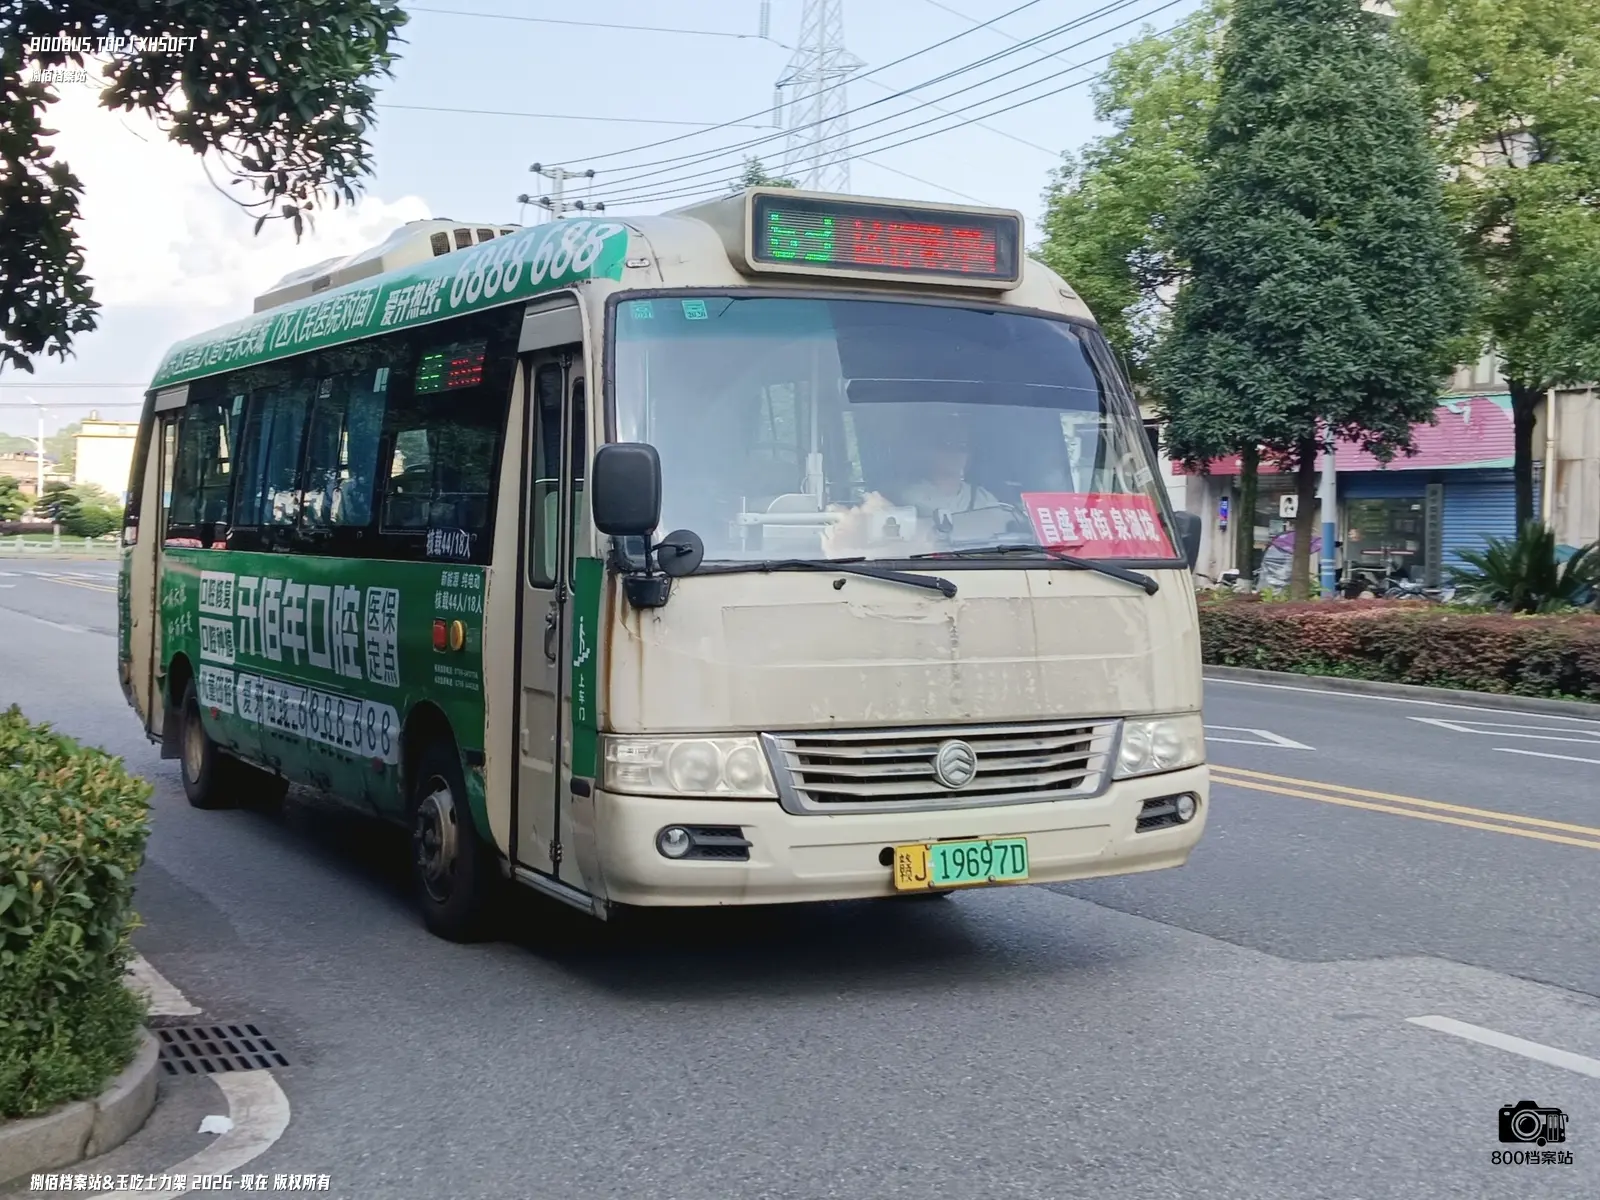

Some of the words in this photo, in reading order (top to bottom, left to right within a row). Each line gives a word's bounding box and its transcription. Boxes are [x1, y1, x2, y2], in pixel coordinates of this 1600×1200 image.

[367, 590, 397, 634] 医保
[367, 639, 398, 684] 定点
[940, 844, 1026, 880] 19697D
